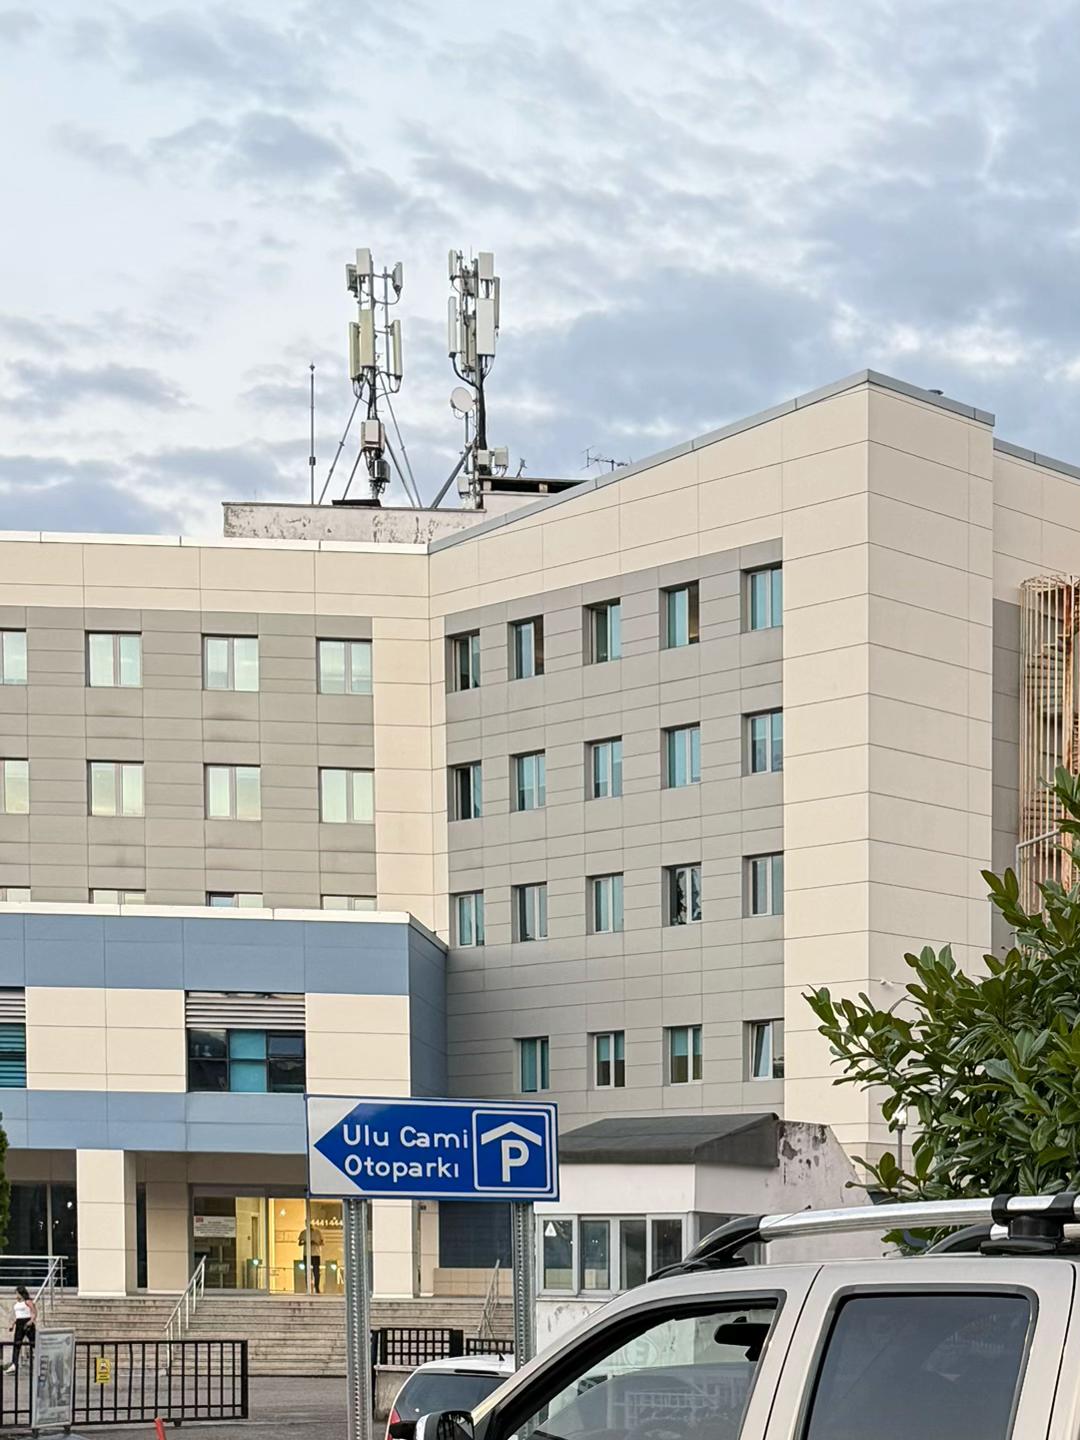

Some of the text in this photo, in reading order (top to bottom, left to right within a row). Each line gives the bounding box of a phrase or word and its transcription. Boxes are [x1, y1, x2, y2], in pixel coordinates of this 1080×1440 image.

[342, 1123, 469, 1149] Ulu Cami
[344, 1154, 459, 1183] Otoparkı
[501, 1139, 530, 1183] P
